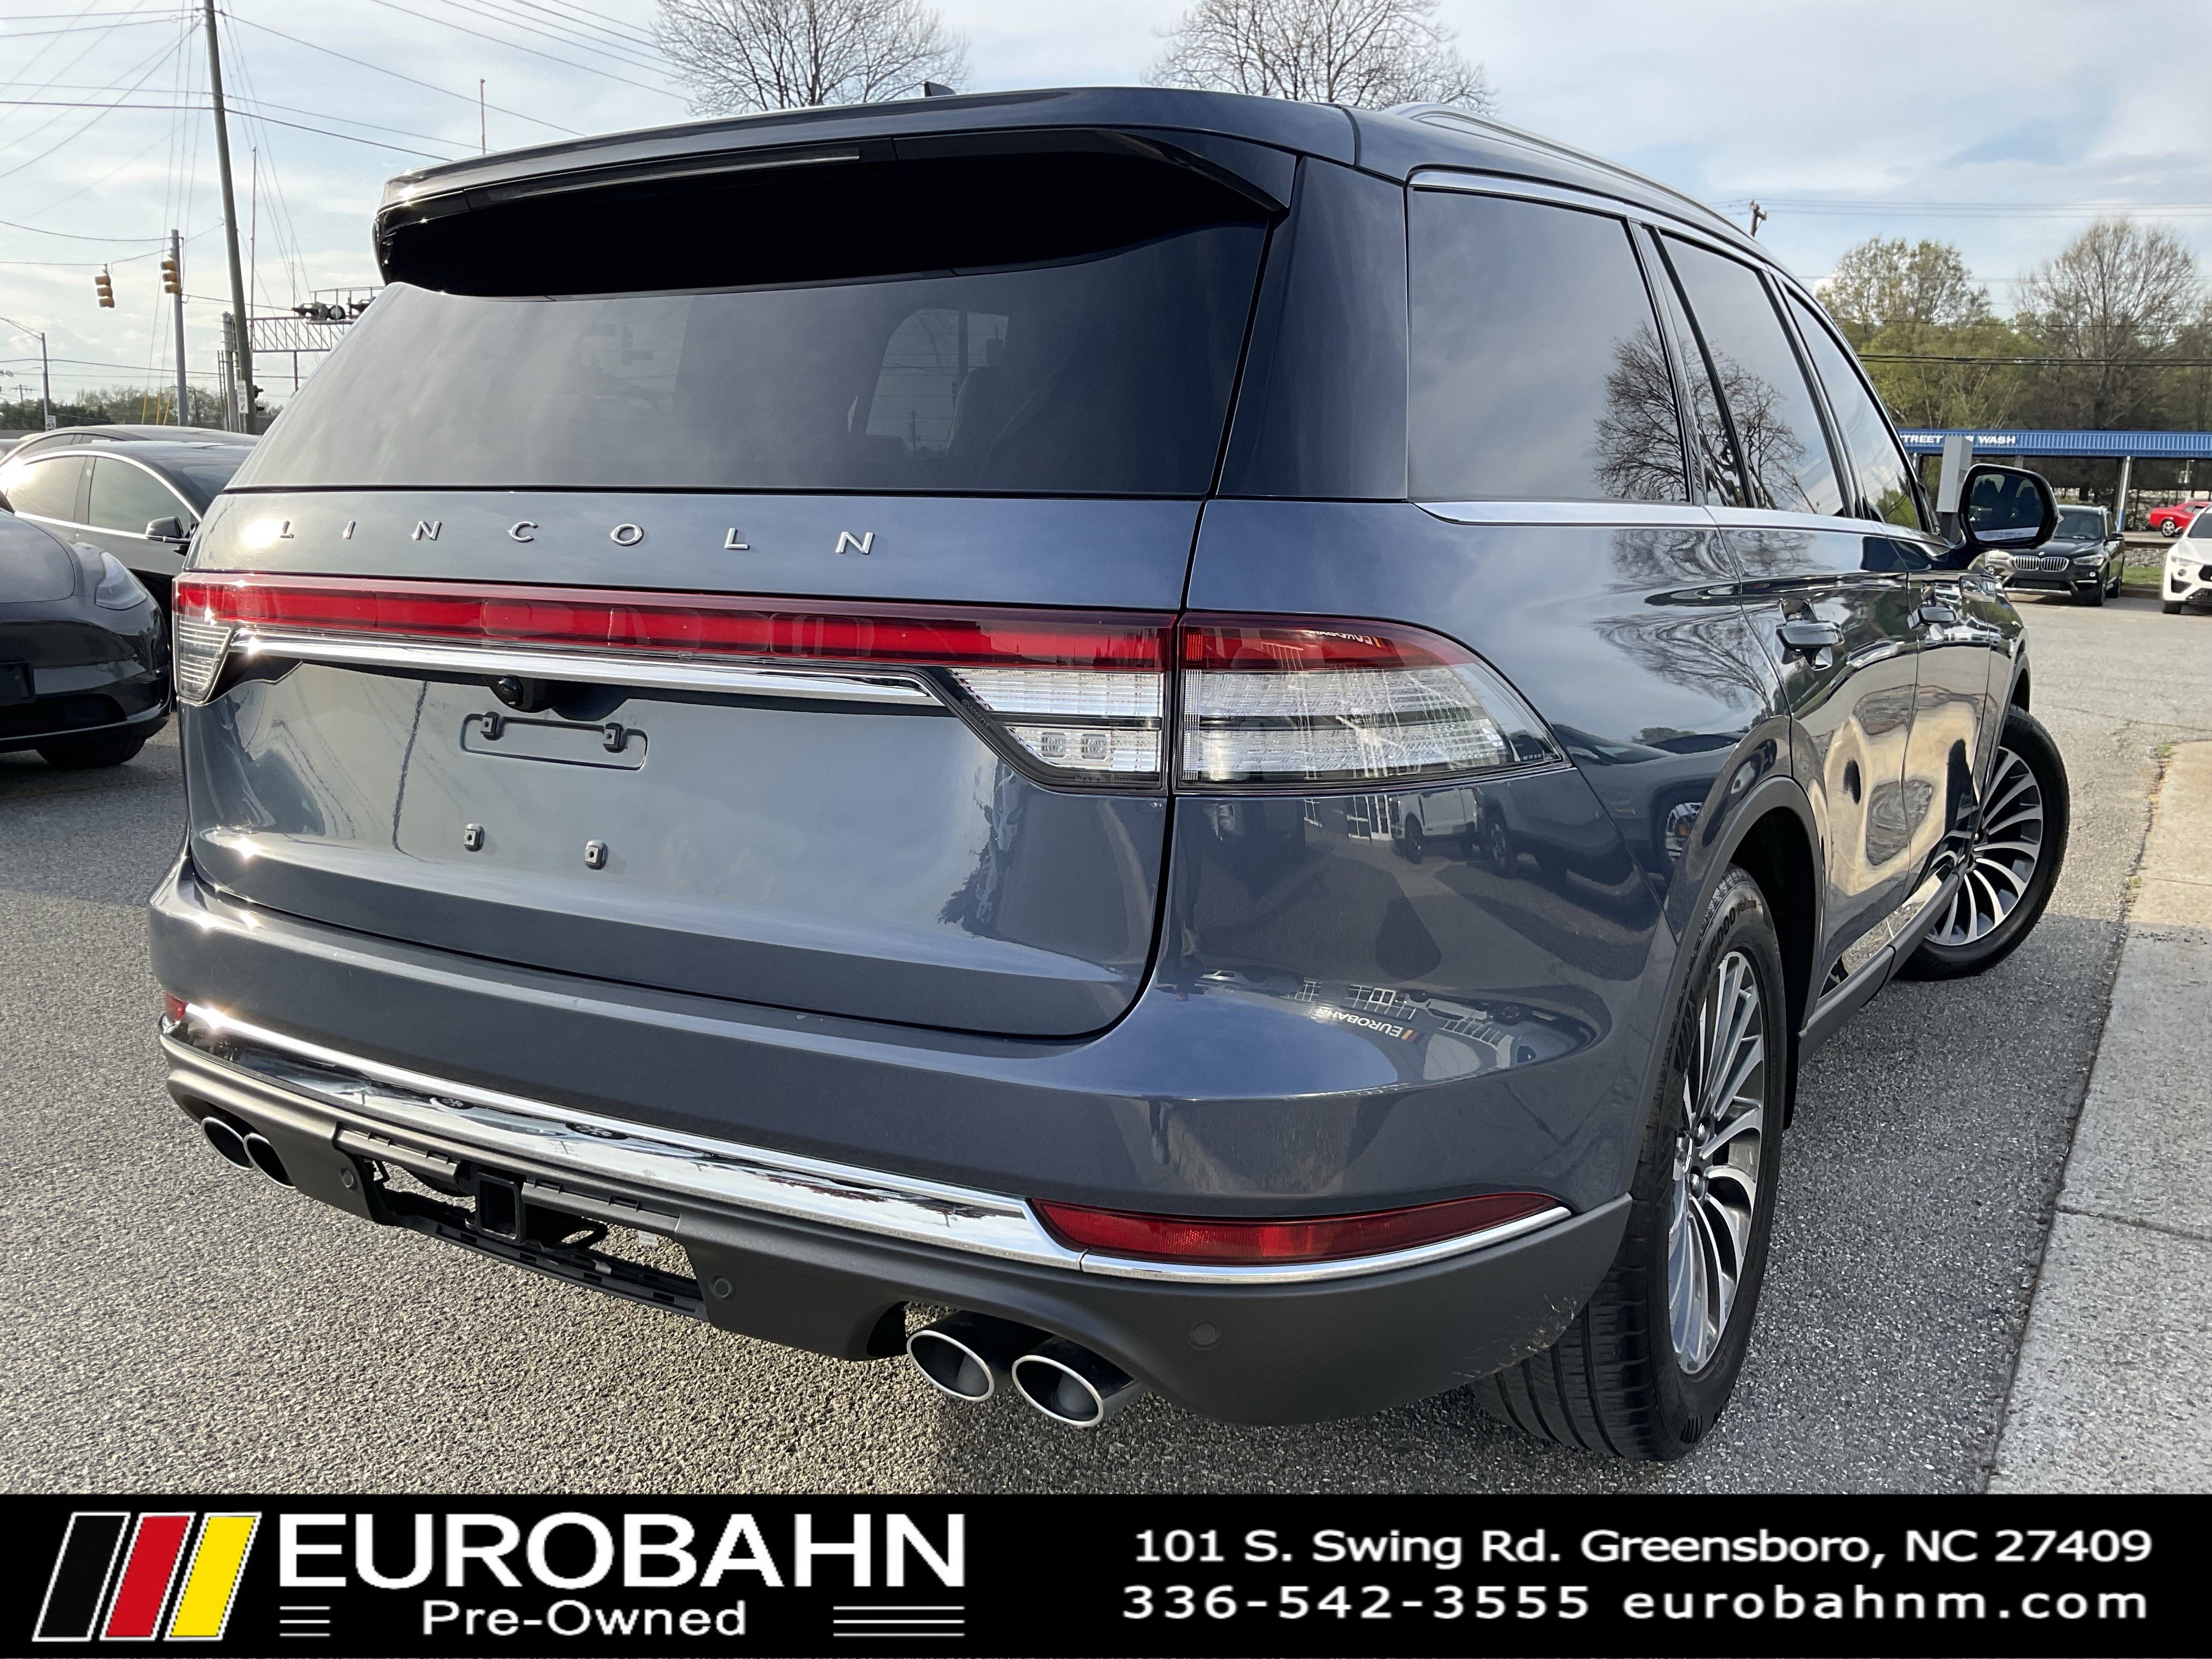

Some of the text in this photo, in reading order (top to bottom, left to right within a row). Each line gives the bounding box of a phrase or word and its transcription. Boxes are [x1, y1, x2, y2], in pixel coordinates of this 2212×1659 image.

[1900, 435, 1944, 443] TREET
[1978, 436, 2016, 444] WASH
[279, 520, 874, 555] LINCOLN
